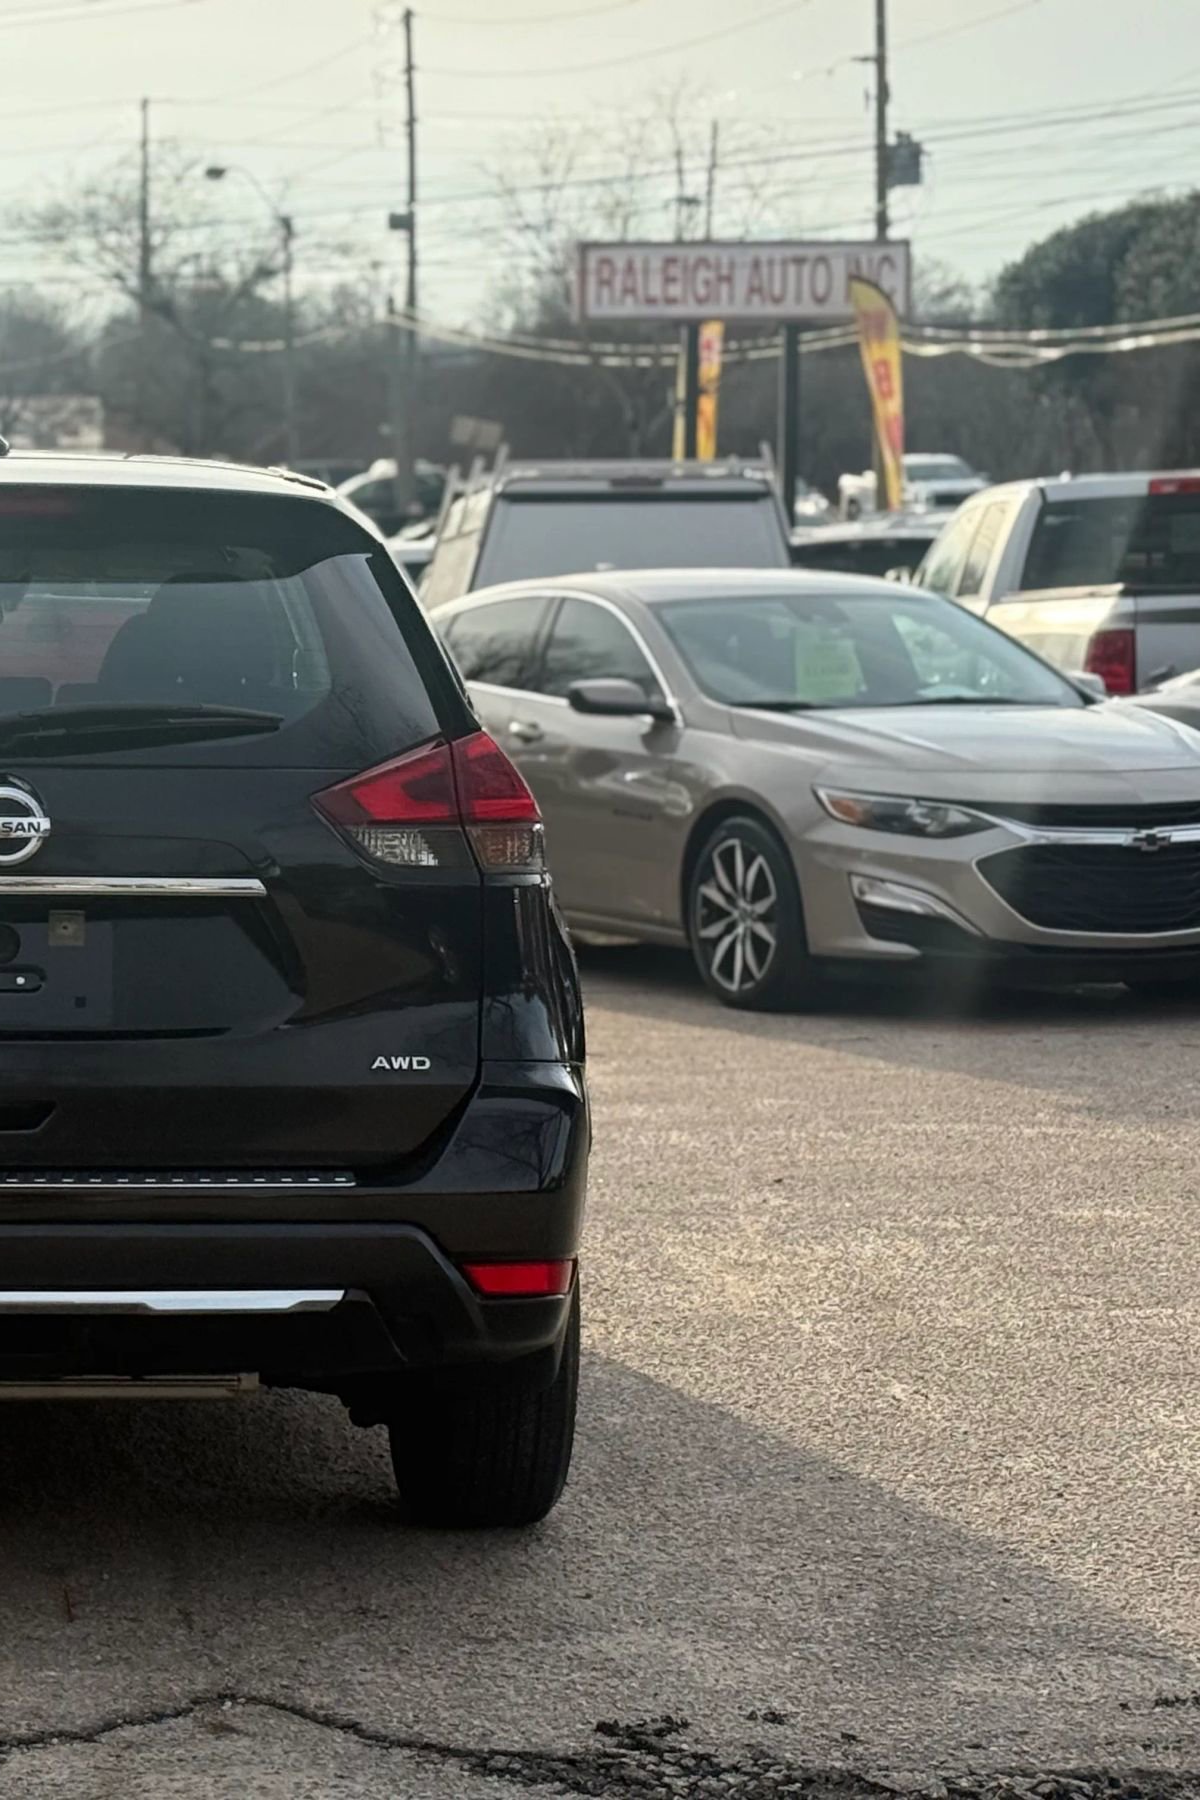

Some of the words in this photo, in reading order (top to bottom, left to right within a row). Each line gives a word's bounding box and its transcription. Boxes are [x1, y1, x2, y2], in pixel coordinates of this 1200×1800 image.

[594, 256, 734, 305] RALEIGH
[744, 254, 834, 304] AUTO
[370, 1055, 431, 1070] AWD
